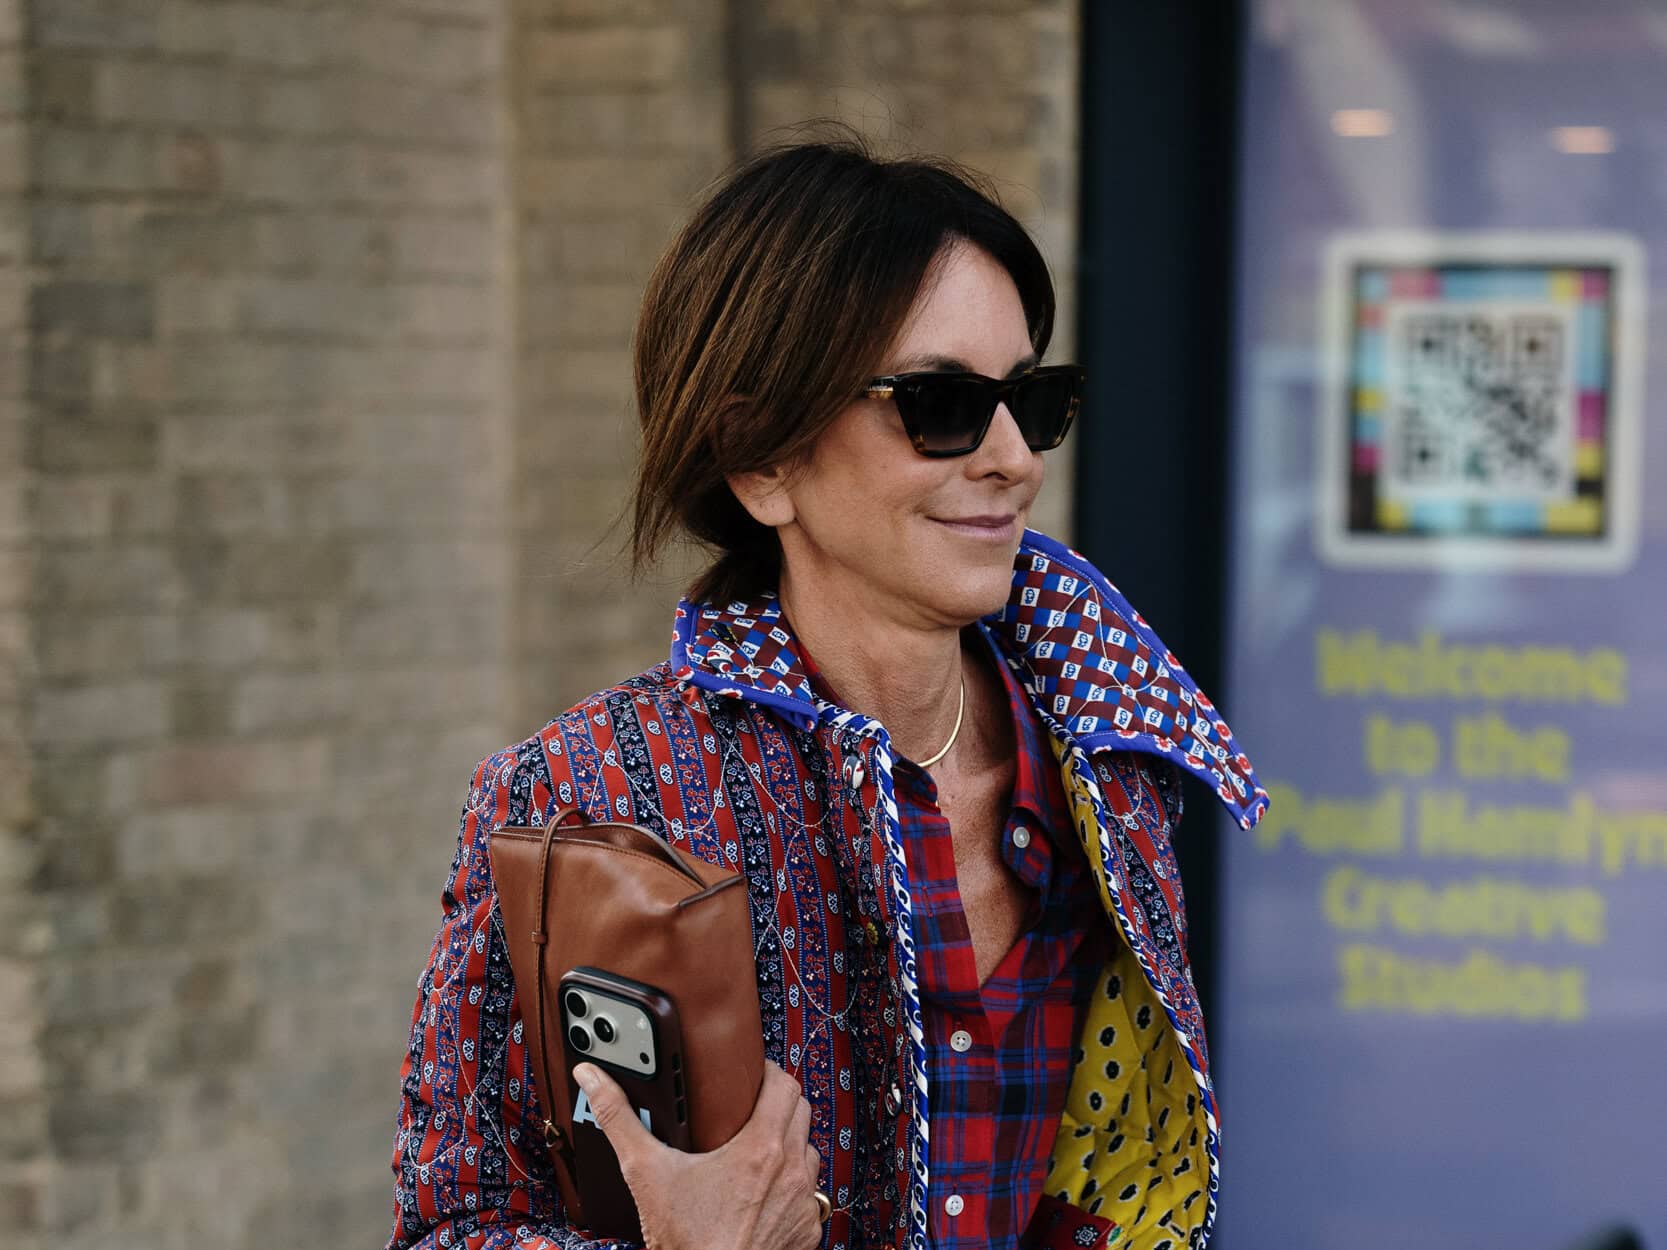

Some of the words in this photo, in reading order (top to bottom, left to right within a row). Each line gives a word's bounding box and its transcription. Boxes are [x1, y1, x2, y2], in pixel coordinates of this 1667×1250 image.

[1321, 632, 1626, 702] Welcome
[1370, 716, 1437, 774] to
[1455, 716, 1569, 780] the
[1324, 868, 1603, 942] Creative
[1341, 946, 1585, 1020] Studios
